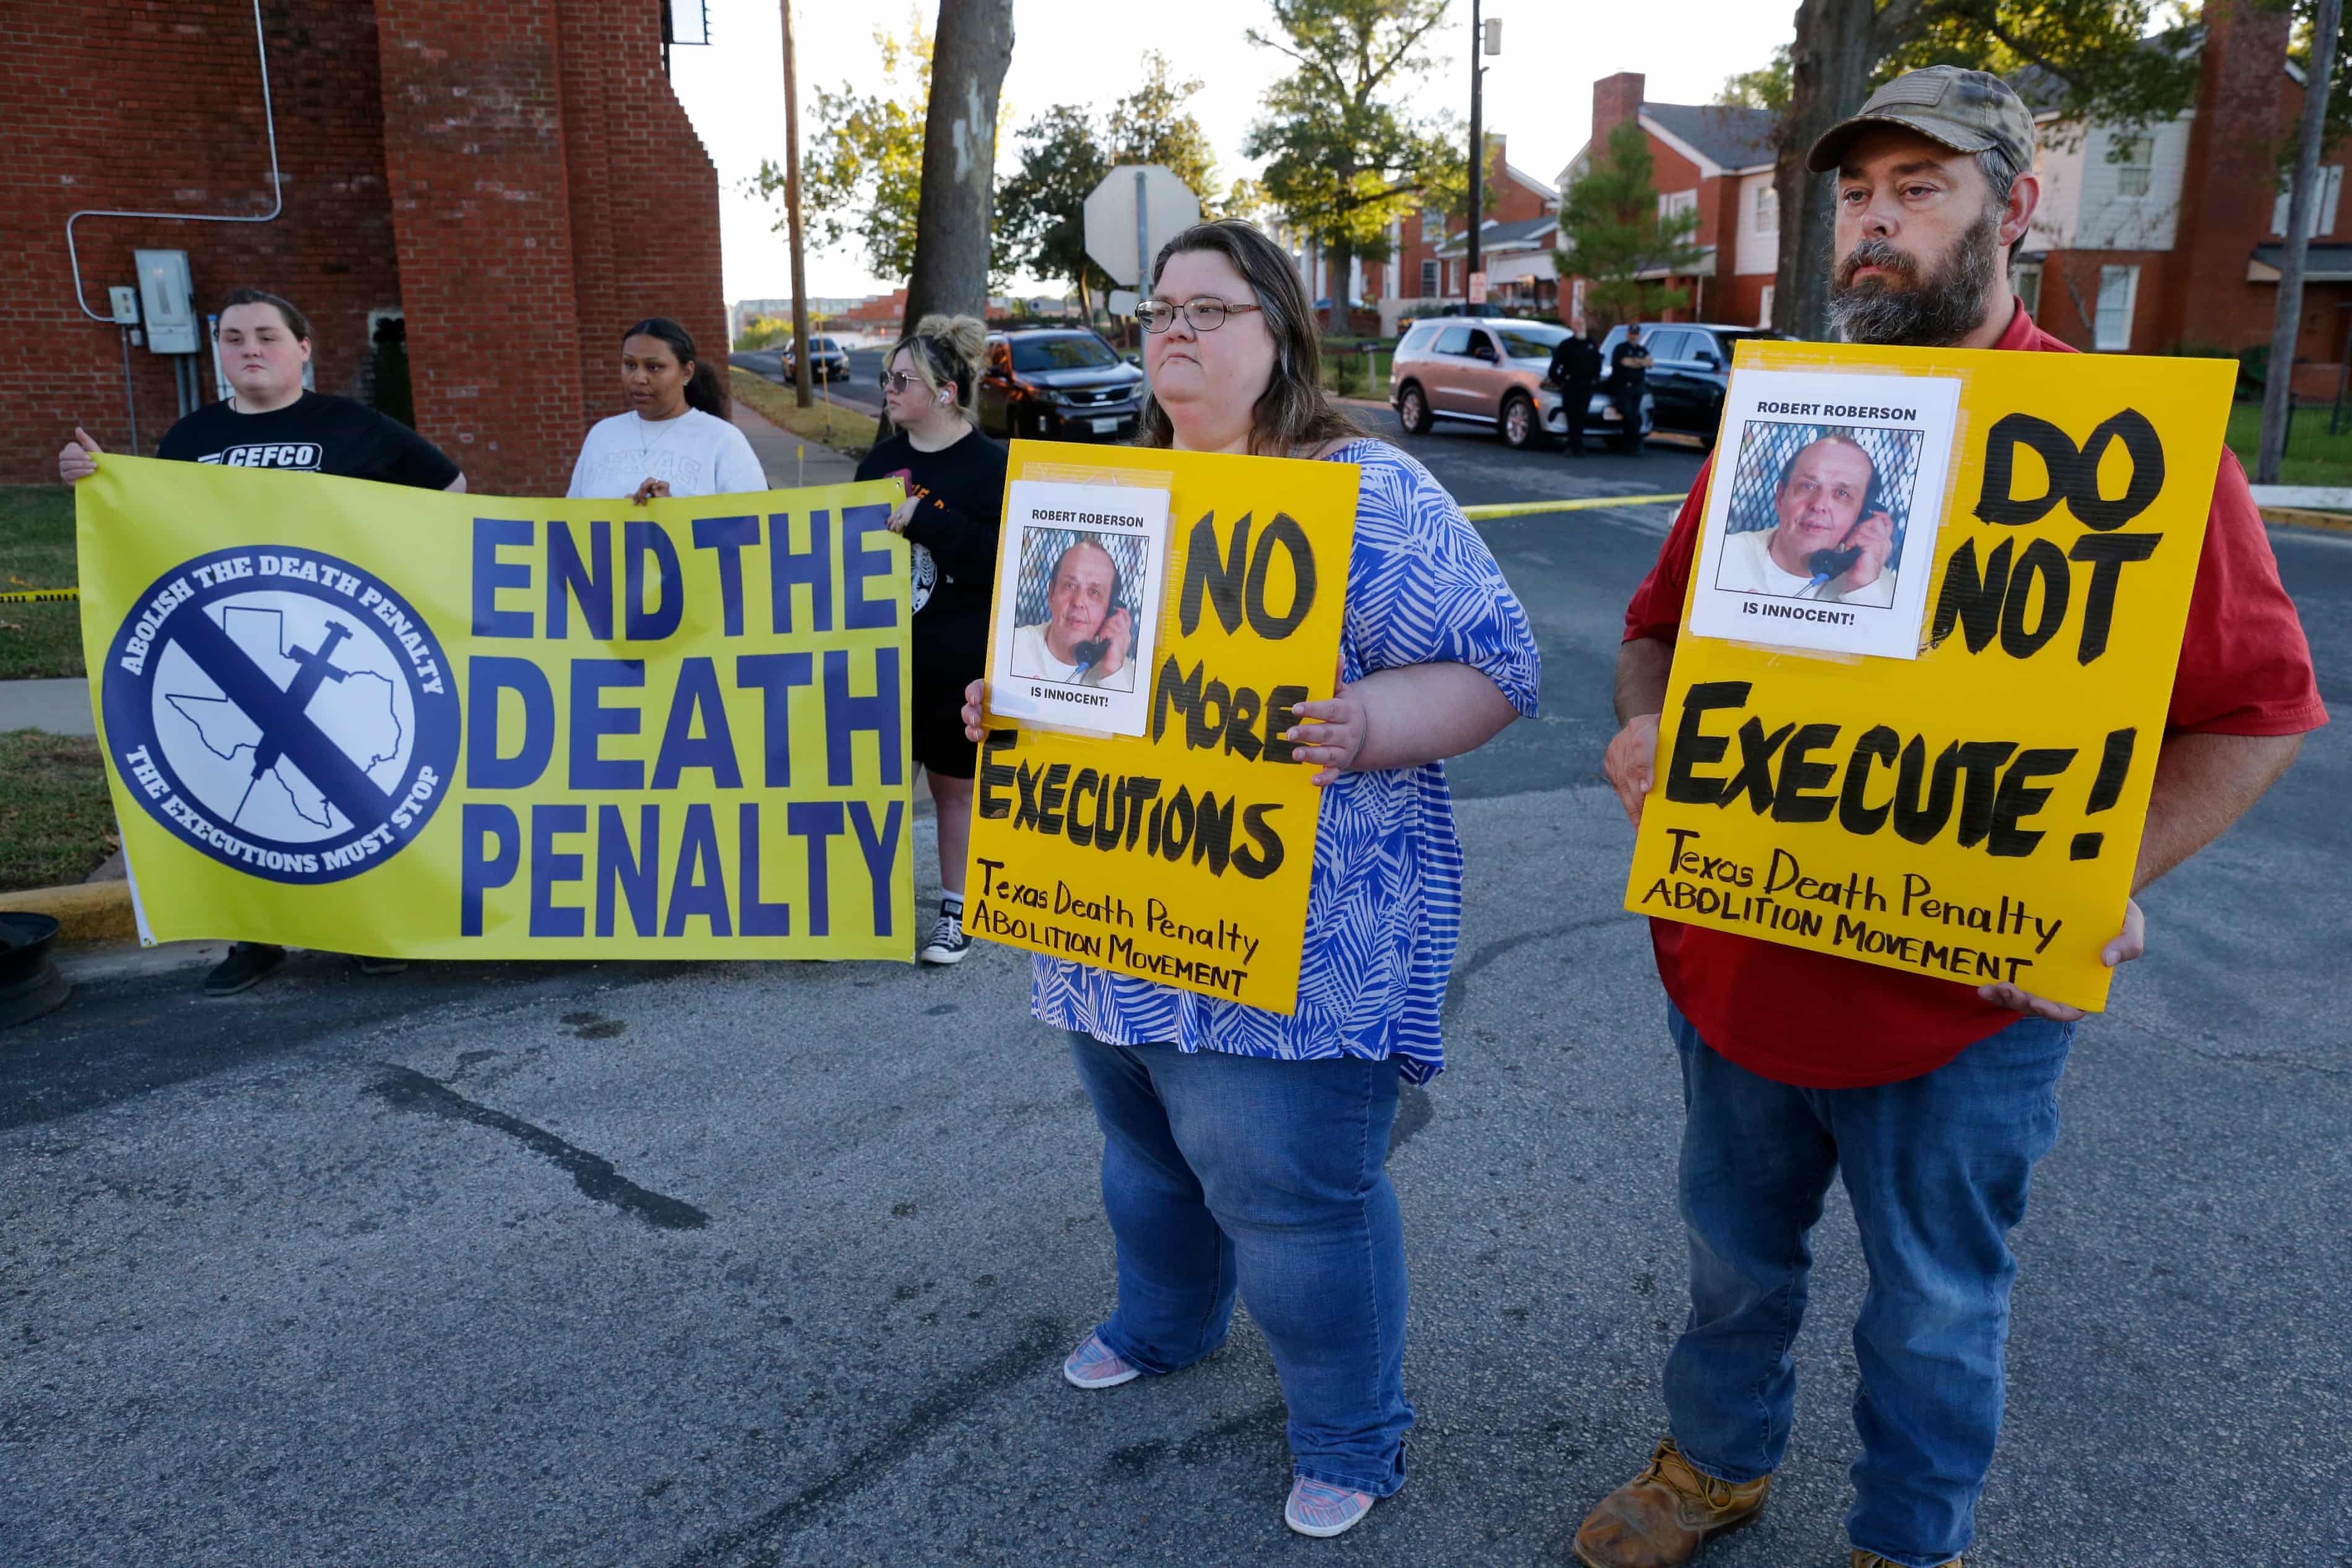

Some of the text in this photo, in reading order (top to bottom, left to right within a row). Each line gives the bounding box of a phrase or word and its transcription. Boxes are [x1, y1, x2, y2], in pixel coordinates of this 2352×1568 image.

[228, 445, 314, 467] CEFCO
[1757, 401, 1916, 421] ROBERT ROBERSON
[1972, 407, 2165, 532] DO
[472, 503, 897, 641] END THE
[1032, 509, 1144, 528] ROBERT ROBERSON
[1179, 510, 1317, 640] NO
[121, 556, 444, 694] ABOLISH THE DEATH PENALTY
[1742, 601, 1854, 626] IS INNOCENT!
[1918, 533, 2163, 666] NOT
[467, 647, 902, 790] DEATH
[1031, 686, 1109, 708] IS INNOCENT!
[1152, 653, 1309, 765] MORE
[127, 744, 440, 874] THE EXECUTIONS MUST STOP
[979, 730, 1284, 879] EXECUTIONS
[460, 800, 904, 937] PENALTY
[977, 858, 1260, 965] Texas Death Penalty
[1641, 877, 2034, 984] ABOLITION MOVEMENT
[1666, 829, 2062, 955] Texas Death Penalty
[972, 900, 1248, 996] ABOLITION MOVEMENT
